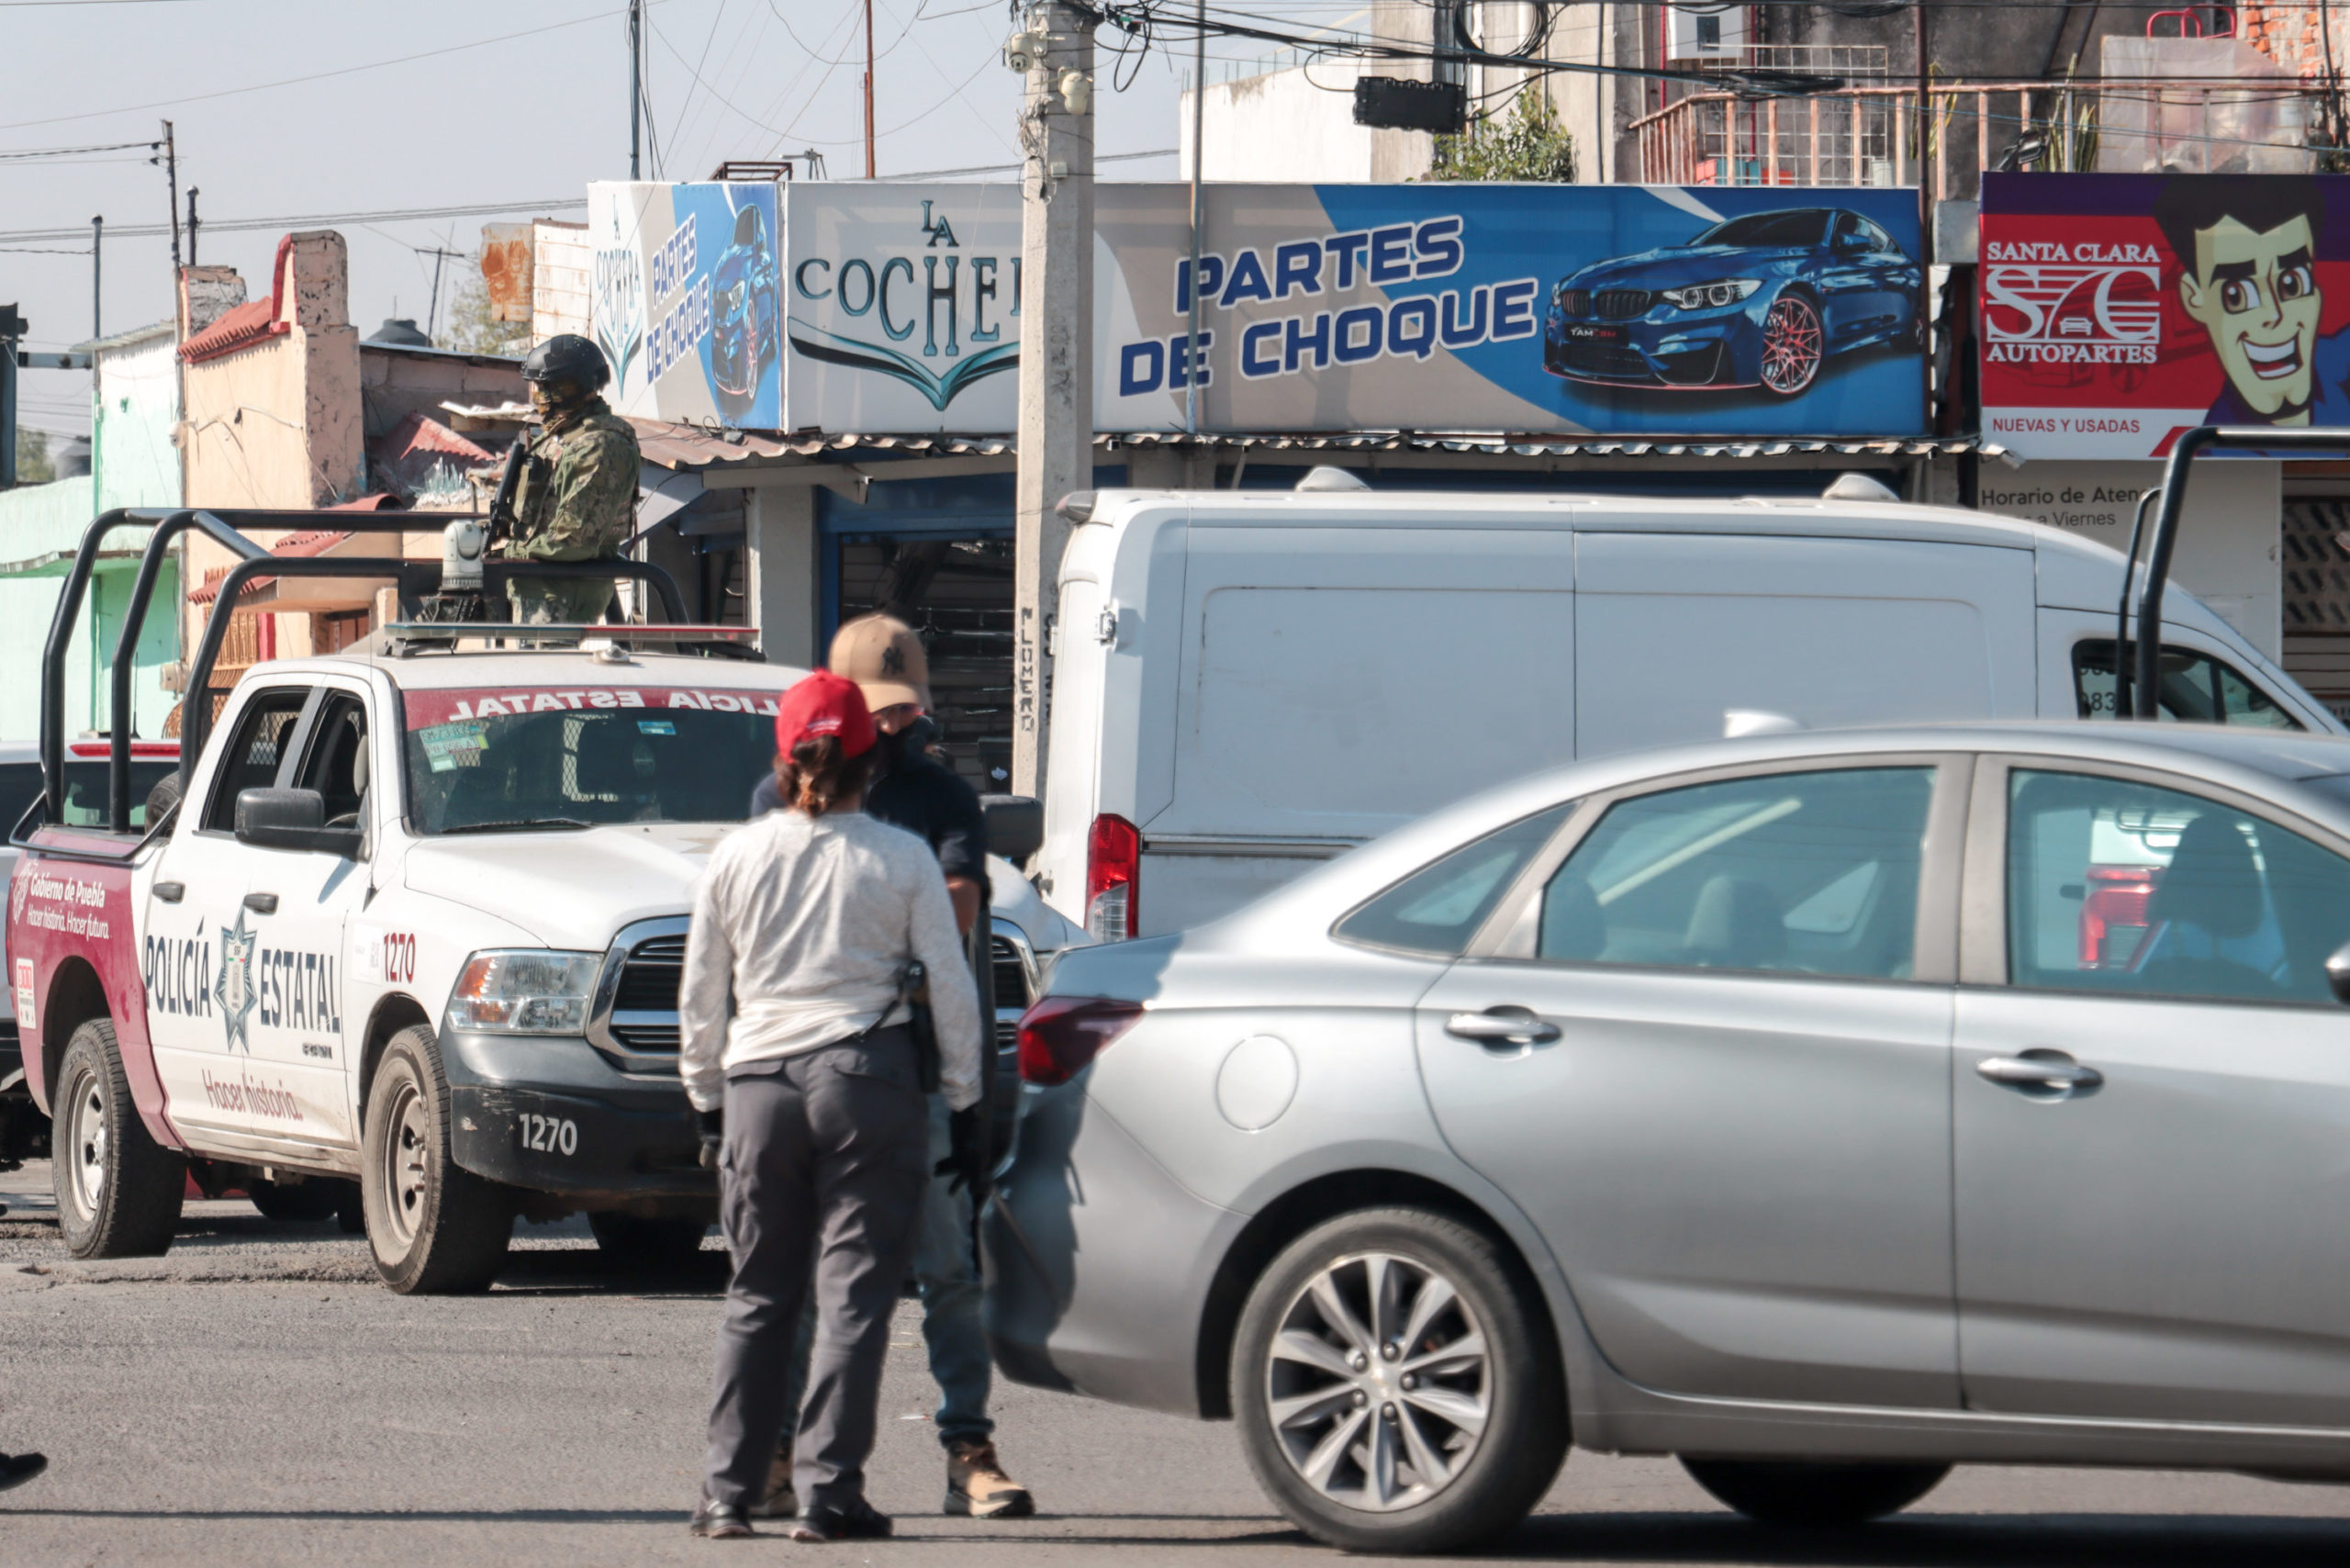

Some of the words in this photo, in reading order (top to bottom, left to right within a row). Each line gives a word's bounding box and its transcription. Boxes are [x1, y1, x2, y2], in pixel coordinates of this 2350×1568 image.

[921, 199, 960, 247] LA
[653, 211, 698, 312] PARTES
[1174, 215, 1465, 317] PARTES
[1986, 241, 2071, 262] SANTA
[2073, 243, 2162, 263] CLARA
[596, 248, 642, 348] COCHERA
[794, 255, 1022, 357] COCHE
[647, 323, 662, 386] DE
[665, 273, 711, 373] CHOQUE
[1118, 330, 1214, 398] DE
[1241, 277, 1539, 381] CHOQUE
[1986, 343, 2158, 364] AUTOPARTES
[1993, 418, 2056, 432] NUEVAS
[2060, 419, 2071, 432] Y
[2075, 419, 2141, 433] USADAS
[1981, 487, 2054, 506] Horario
[2060, 487, 2086, 504] de
[2092, 486, 2147, 503] Aten
[2053, 511, 2116, 527] Viernes
[30, 872, 64, 902] Gobierno
[64, 877, 75, 903] de
[75, 880, 106, 908] Puebla
[27, 903, 44, 927] Hacer
[66, 911, 87, 935] Hacer
[86, 913, 109, 942] futuro.
[146, 915, 212, 1018] POLICÍA
[261, 948, 341, 1034] ESTATAL
[384, 932, 416, 984] 1270
[202, 1068, 246, 1114] Hacer
[241, 1071, 304, 1121] historia.
[519, 1114, 578, 1156] 1270
